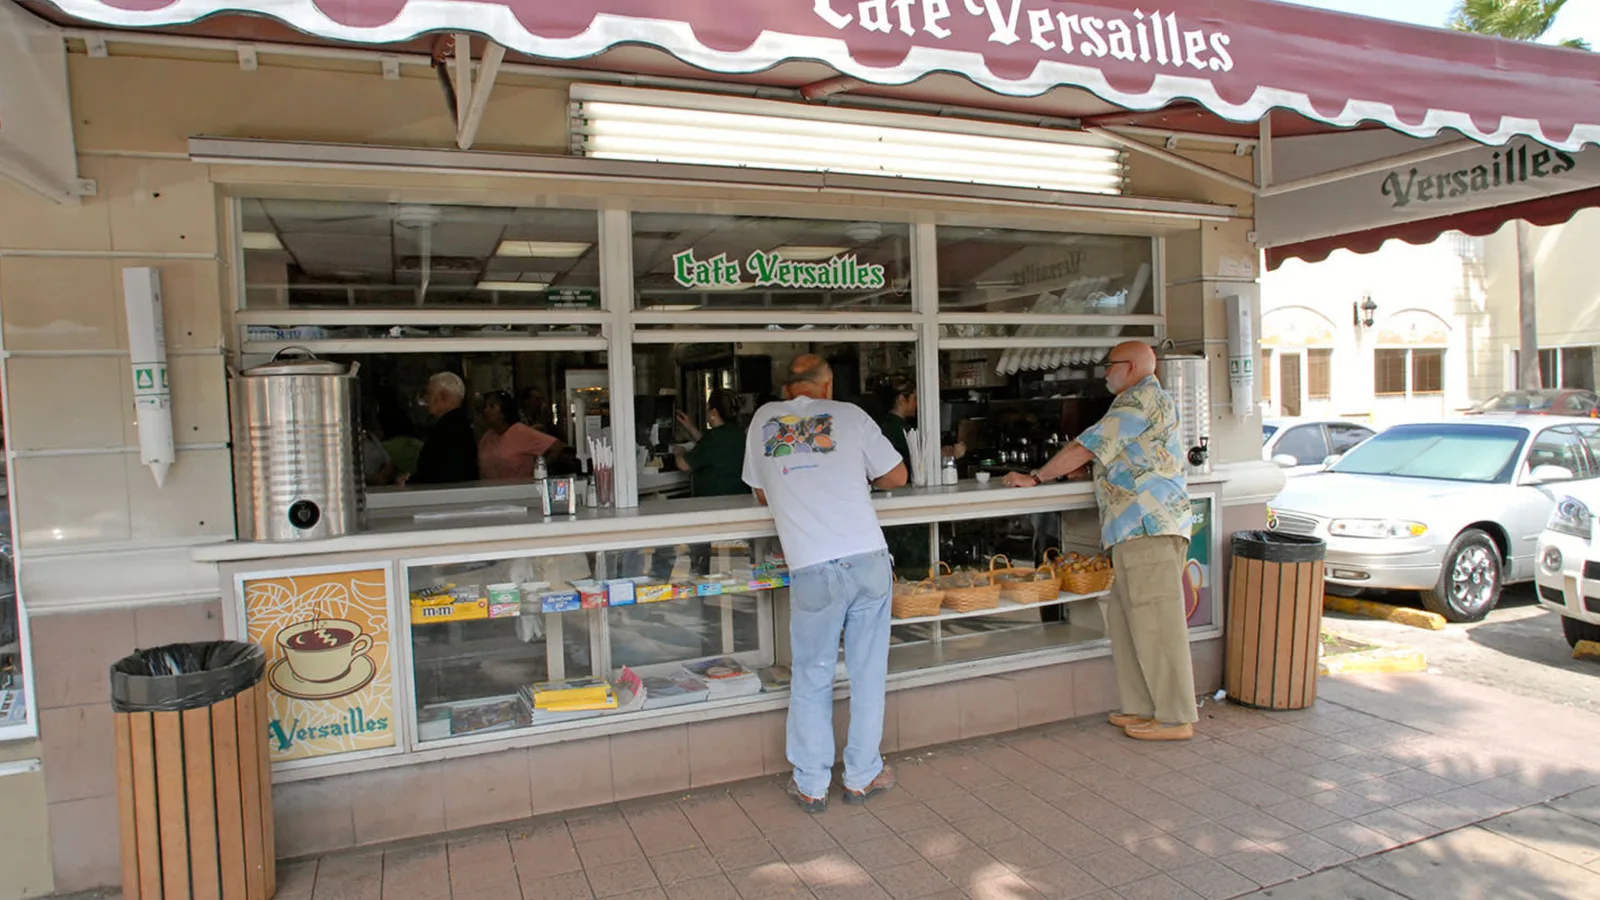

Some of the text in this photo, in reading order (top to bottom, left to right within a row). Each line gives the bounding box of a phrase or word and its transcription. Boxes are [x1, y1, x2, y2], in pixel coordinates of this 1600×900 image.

[963, 0, 1234, 72] Versailles
[1380, 144, 1576, 208] Versailles
[674, 249, 884, 288] Cafe Versailles
[268, 706, 388, 751] Versailles
